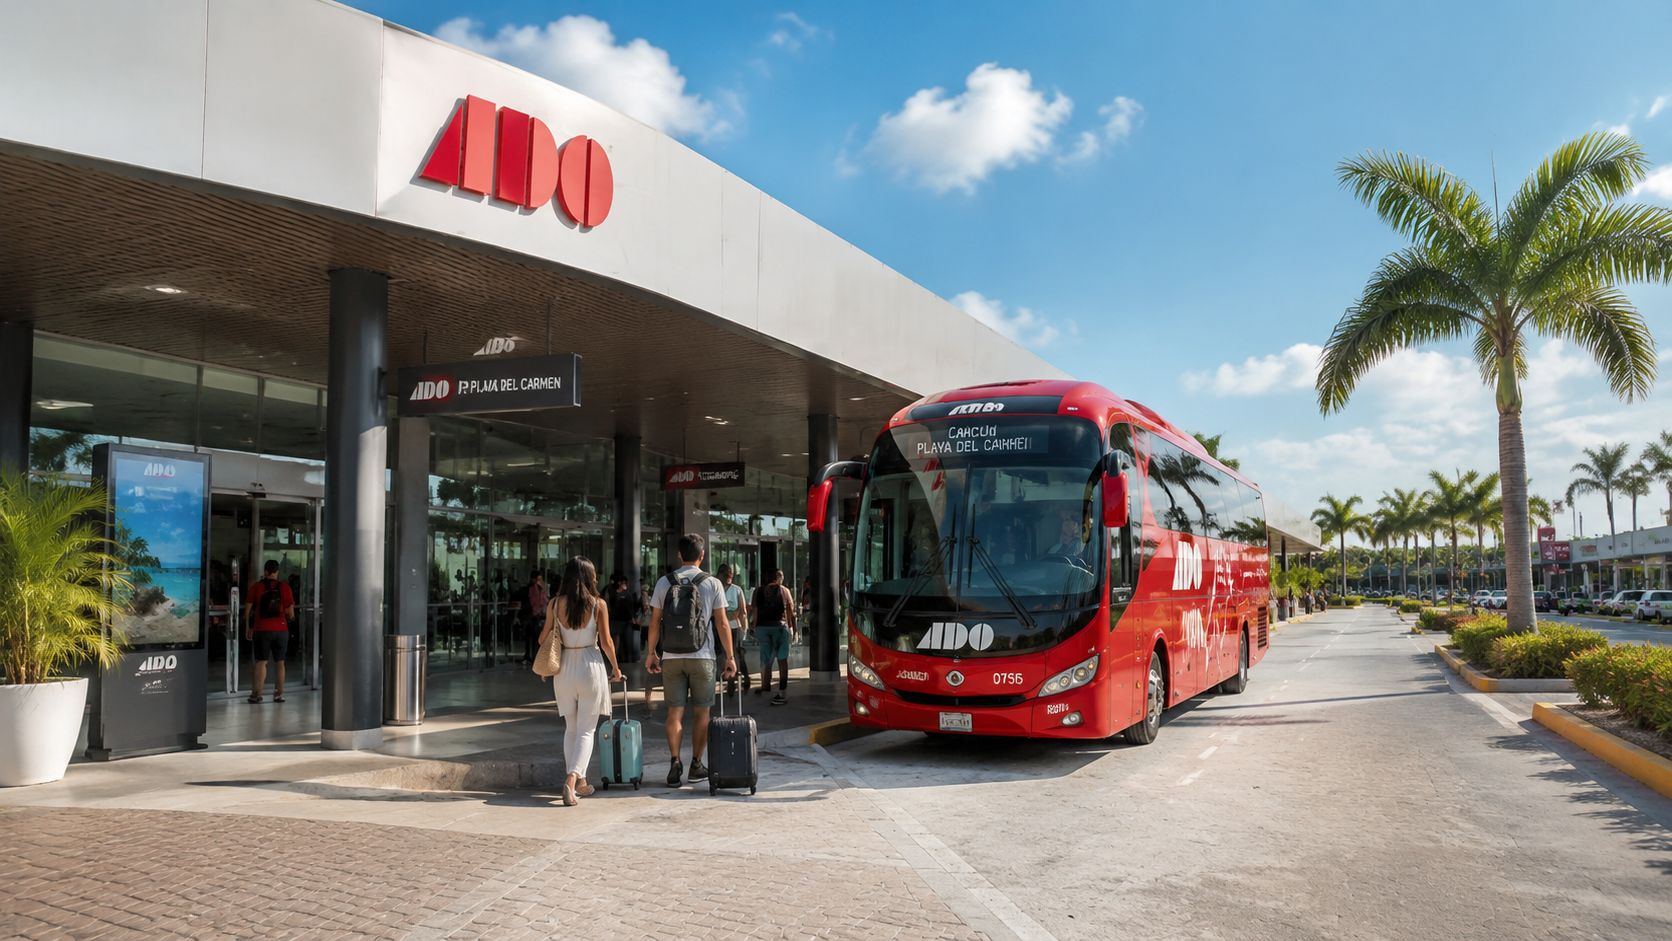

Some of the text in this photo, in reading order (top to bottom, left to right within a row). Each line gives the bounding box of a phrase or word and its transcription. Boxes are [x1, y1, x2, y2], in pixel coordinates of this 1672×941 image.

[419, 94, 614, 228] ADO
[409, 380, 450, 401] ADO
[520, 376, 561, 391] CARMEN
[916, 441, 953, 455] PLAYA
[956, 440, 979, 453] DEL
[1172, 541, 1203, 591] ADO
[916, 622, 995, 651] ADO
[138, 655, 178, 670] ADO
